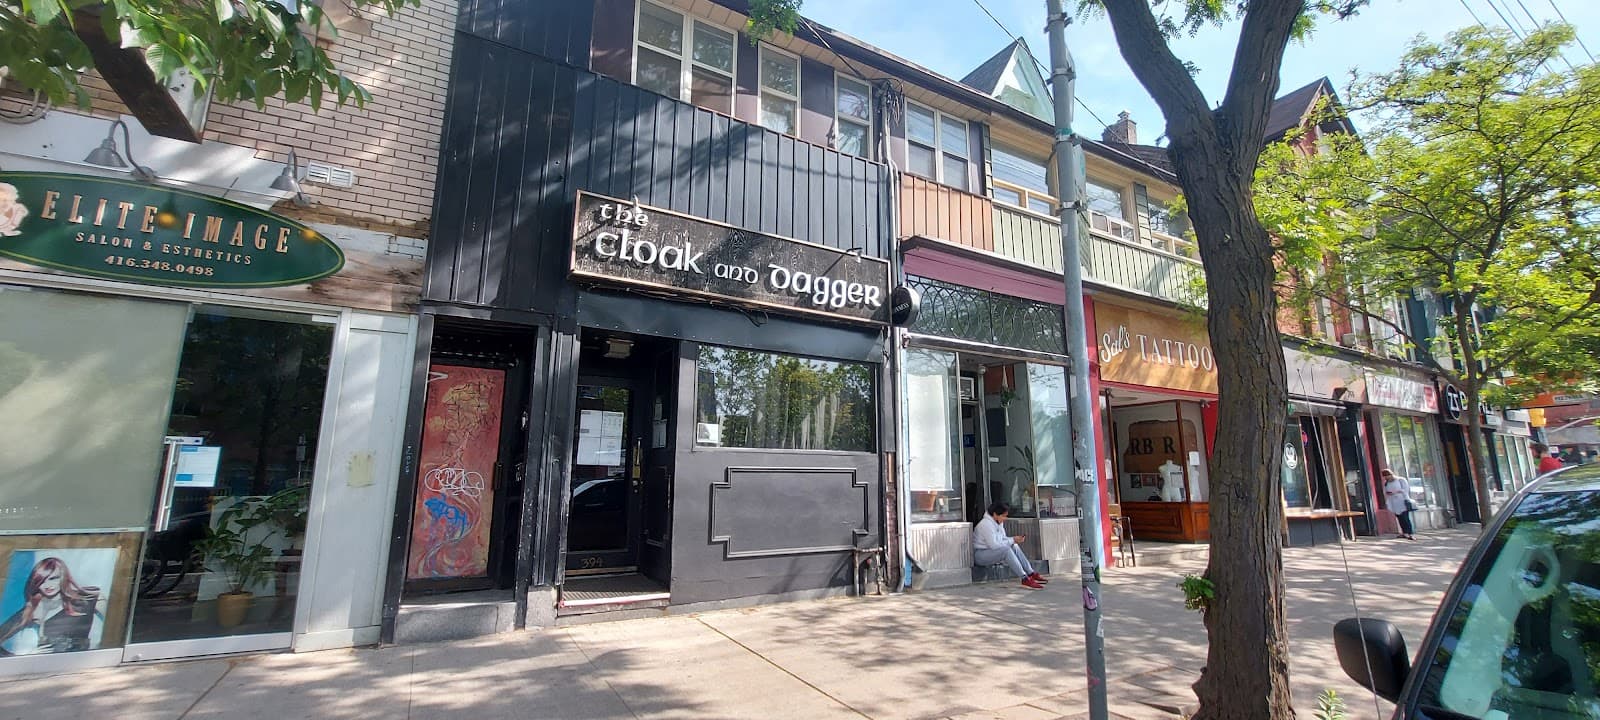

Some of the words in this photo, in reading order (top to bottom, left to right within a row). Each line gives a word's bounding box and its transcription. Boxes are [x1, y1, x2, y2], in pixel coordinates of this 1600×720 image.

[41, 190, 158, 233] ELITE
[183, 212, 291, 253] IMAGE
[599, 203, 650, 227] the
[76, 232, 133, 250] SALON
[143, 240, 152, 251] &
[162, 244, 252, 265] ESTHETICS
[104, 254, 214, 277] 416.348.0498
[1100, 325, 1130, 363] Sal's
[1136, 334, 1213, 372] TATTOO
